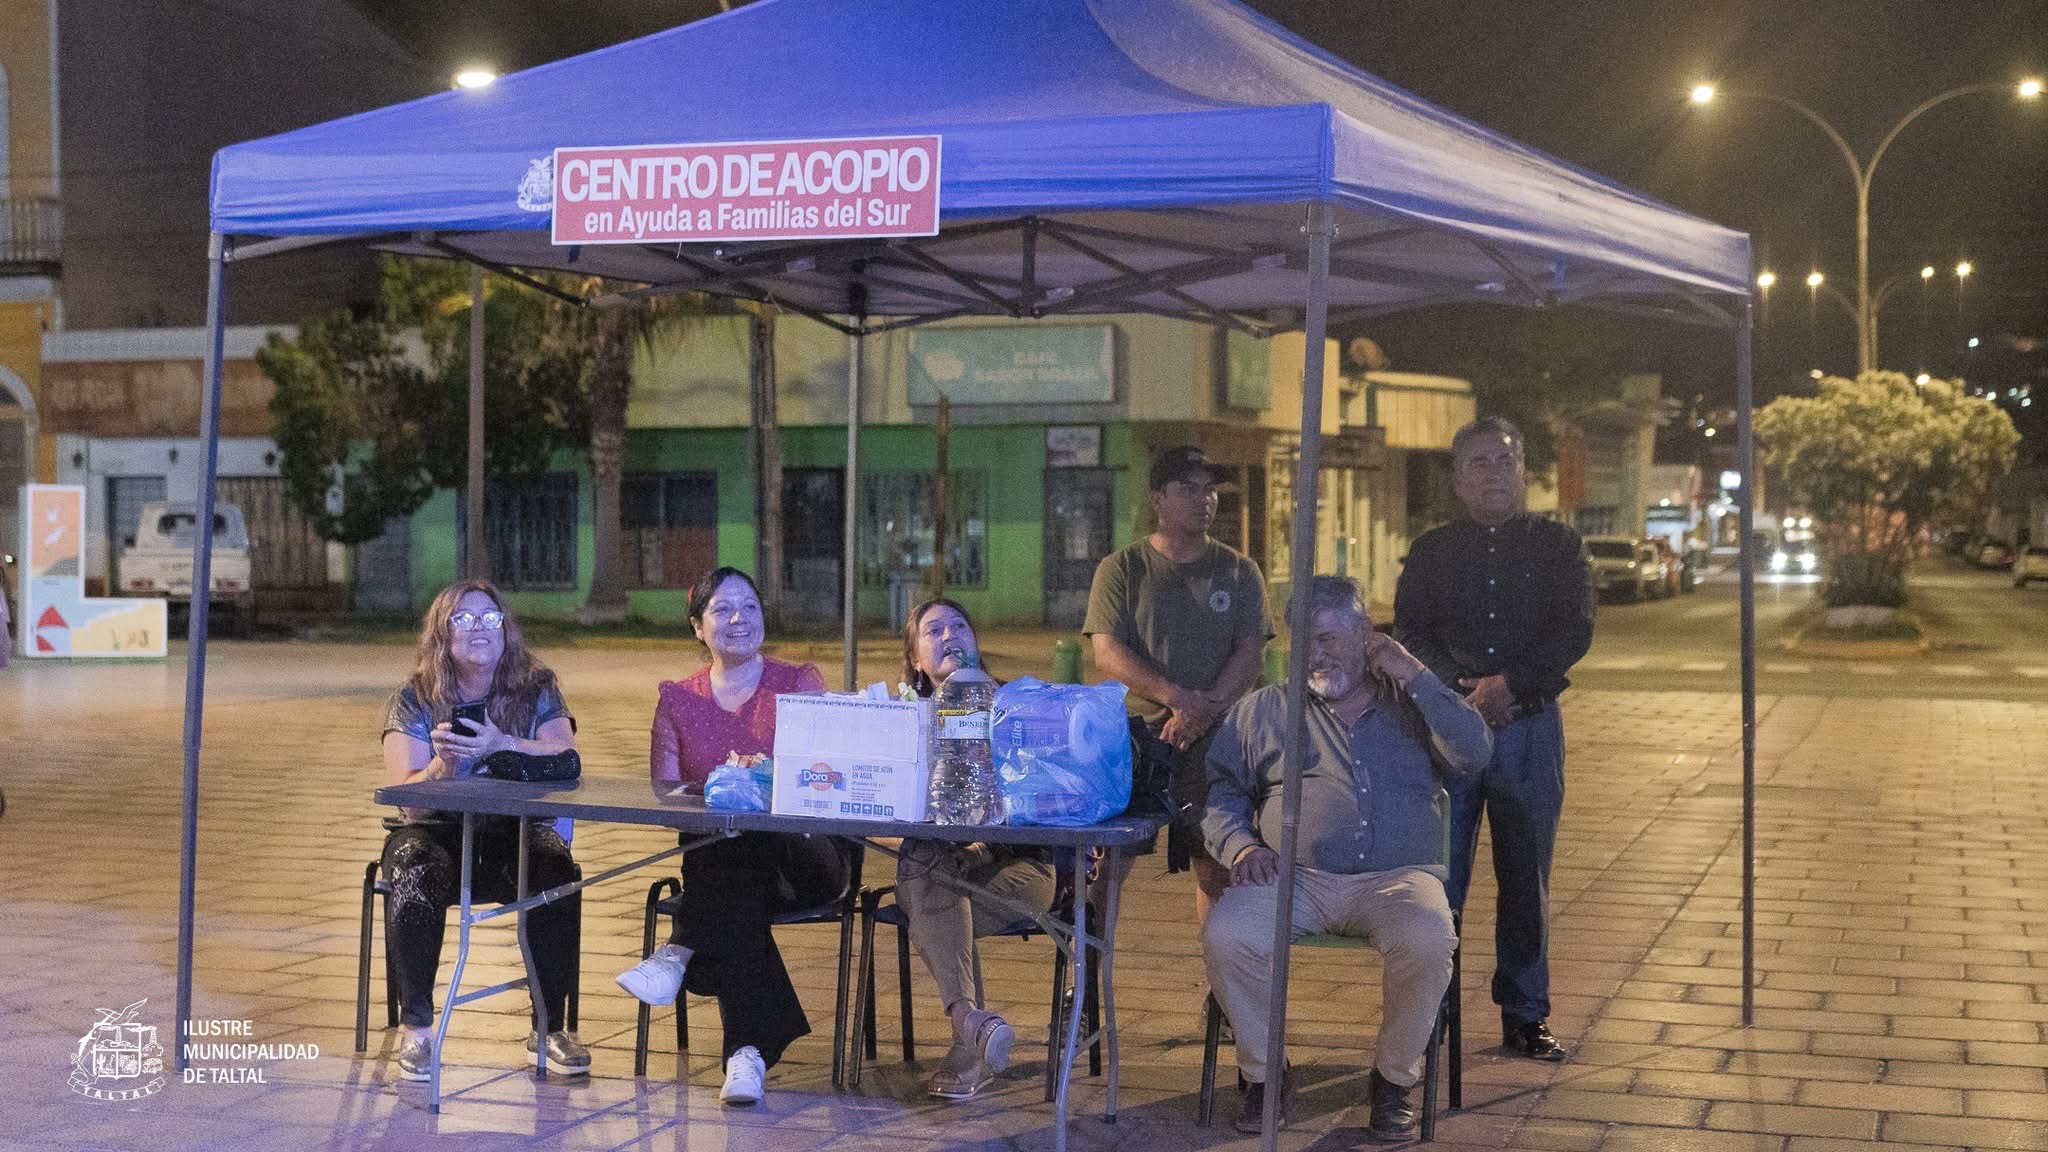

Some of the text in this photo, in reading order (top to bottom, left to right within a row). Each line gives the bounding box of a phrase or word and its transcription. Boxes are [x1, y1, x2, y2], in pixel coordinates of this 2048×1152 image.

[561, 147, 930, 202] CENTRO DE ACOPIO
[585, 198, 911, 239] en Ayuda a Familias del Sur
